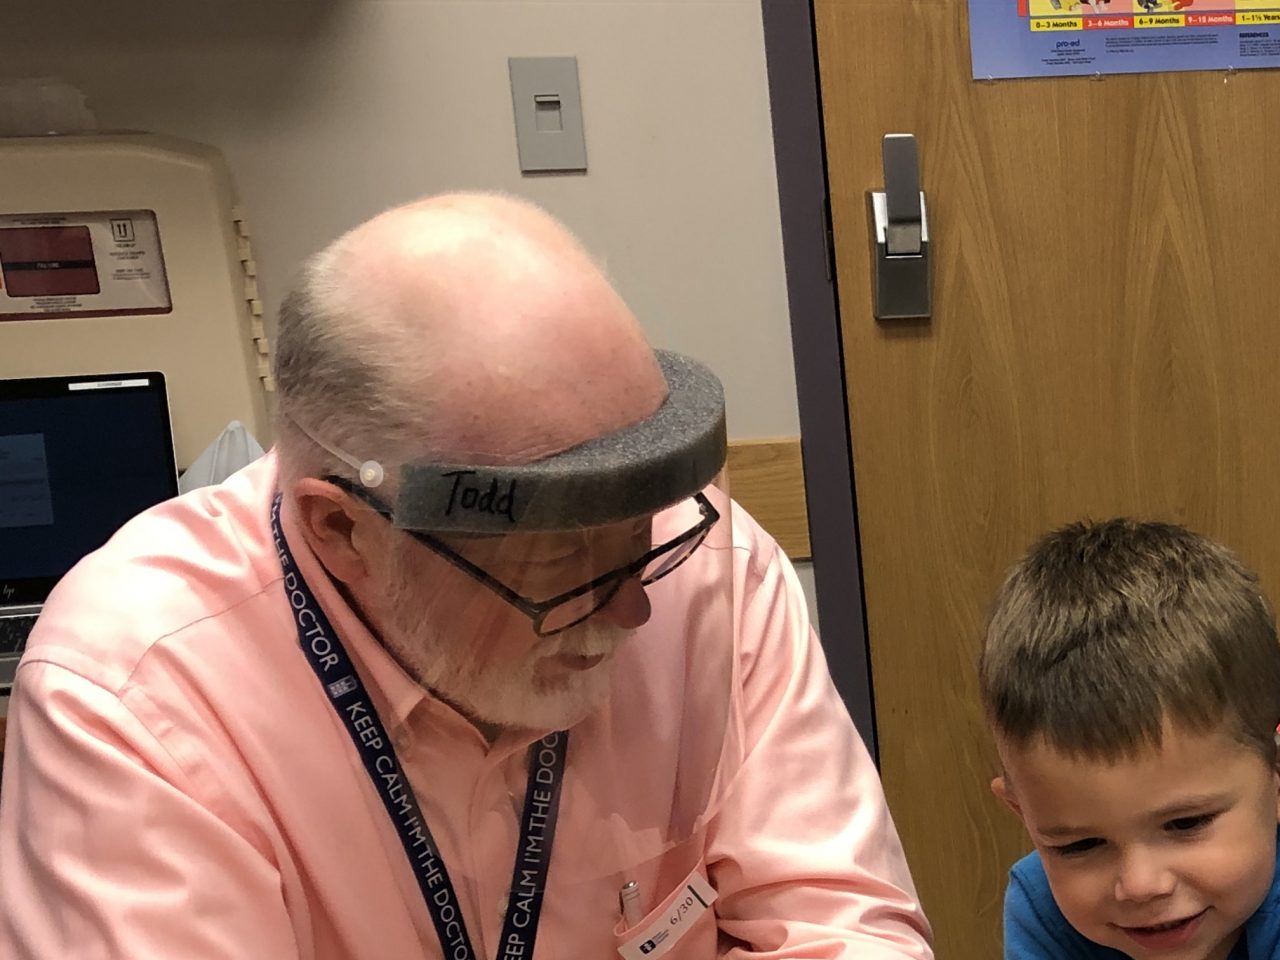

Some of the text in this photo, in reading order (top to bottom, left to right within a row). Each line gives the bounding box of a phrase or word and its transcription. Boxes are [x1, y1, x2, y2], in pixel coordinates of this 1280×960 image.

[1052, 20, 1077, 28] Months
[1208, 15, 1233, 23] Months
[442, 471, 516, 522] Todd
[285, 572, 339, 671] DOCTOR
[346, 701, 383, 751] KEEP
[375, 755, 412, 816] CALM
[404, 816, 426, 848] I'M
[417, 845, 444, 889] THE
[528, 790, 552, 832] THE
[524, 835, 543, 864] I'M
[512, 869, 538, 928] CALM
[670, 896, 694, 925] 6/30
